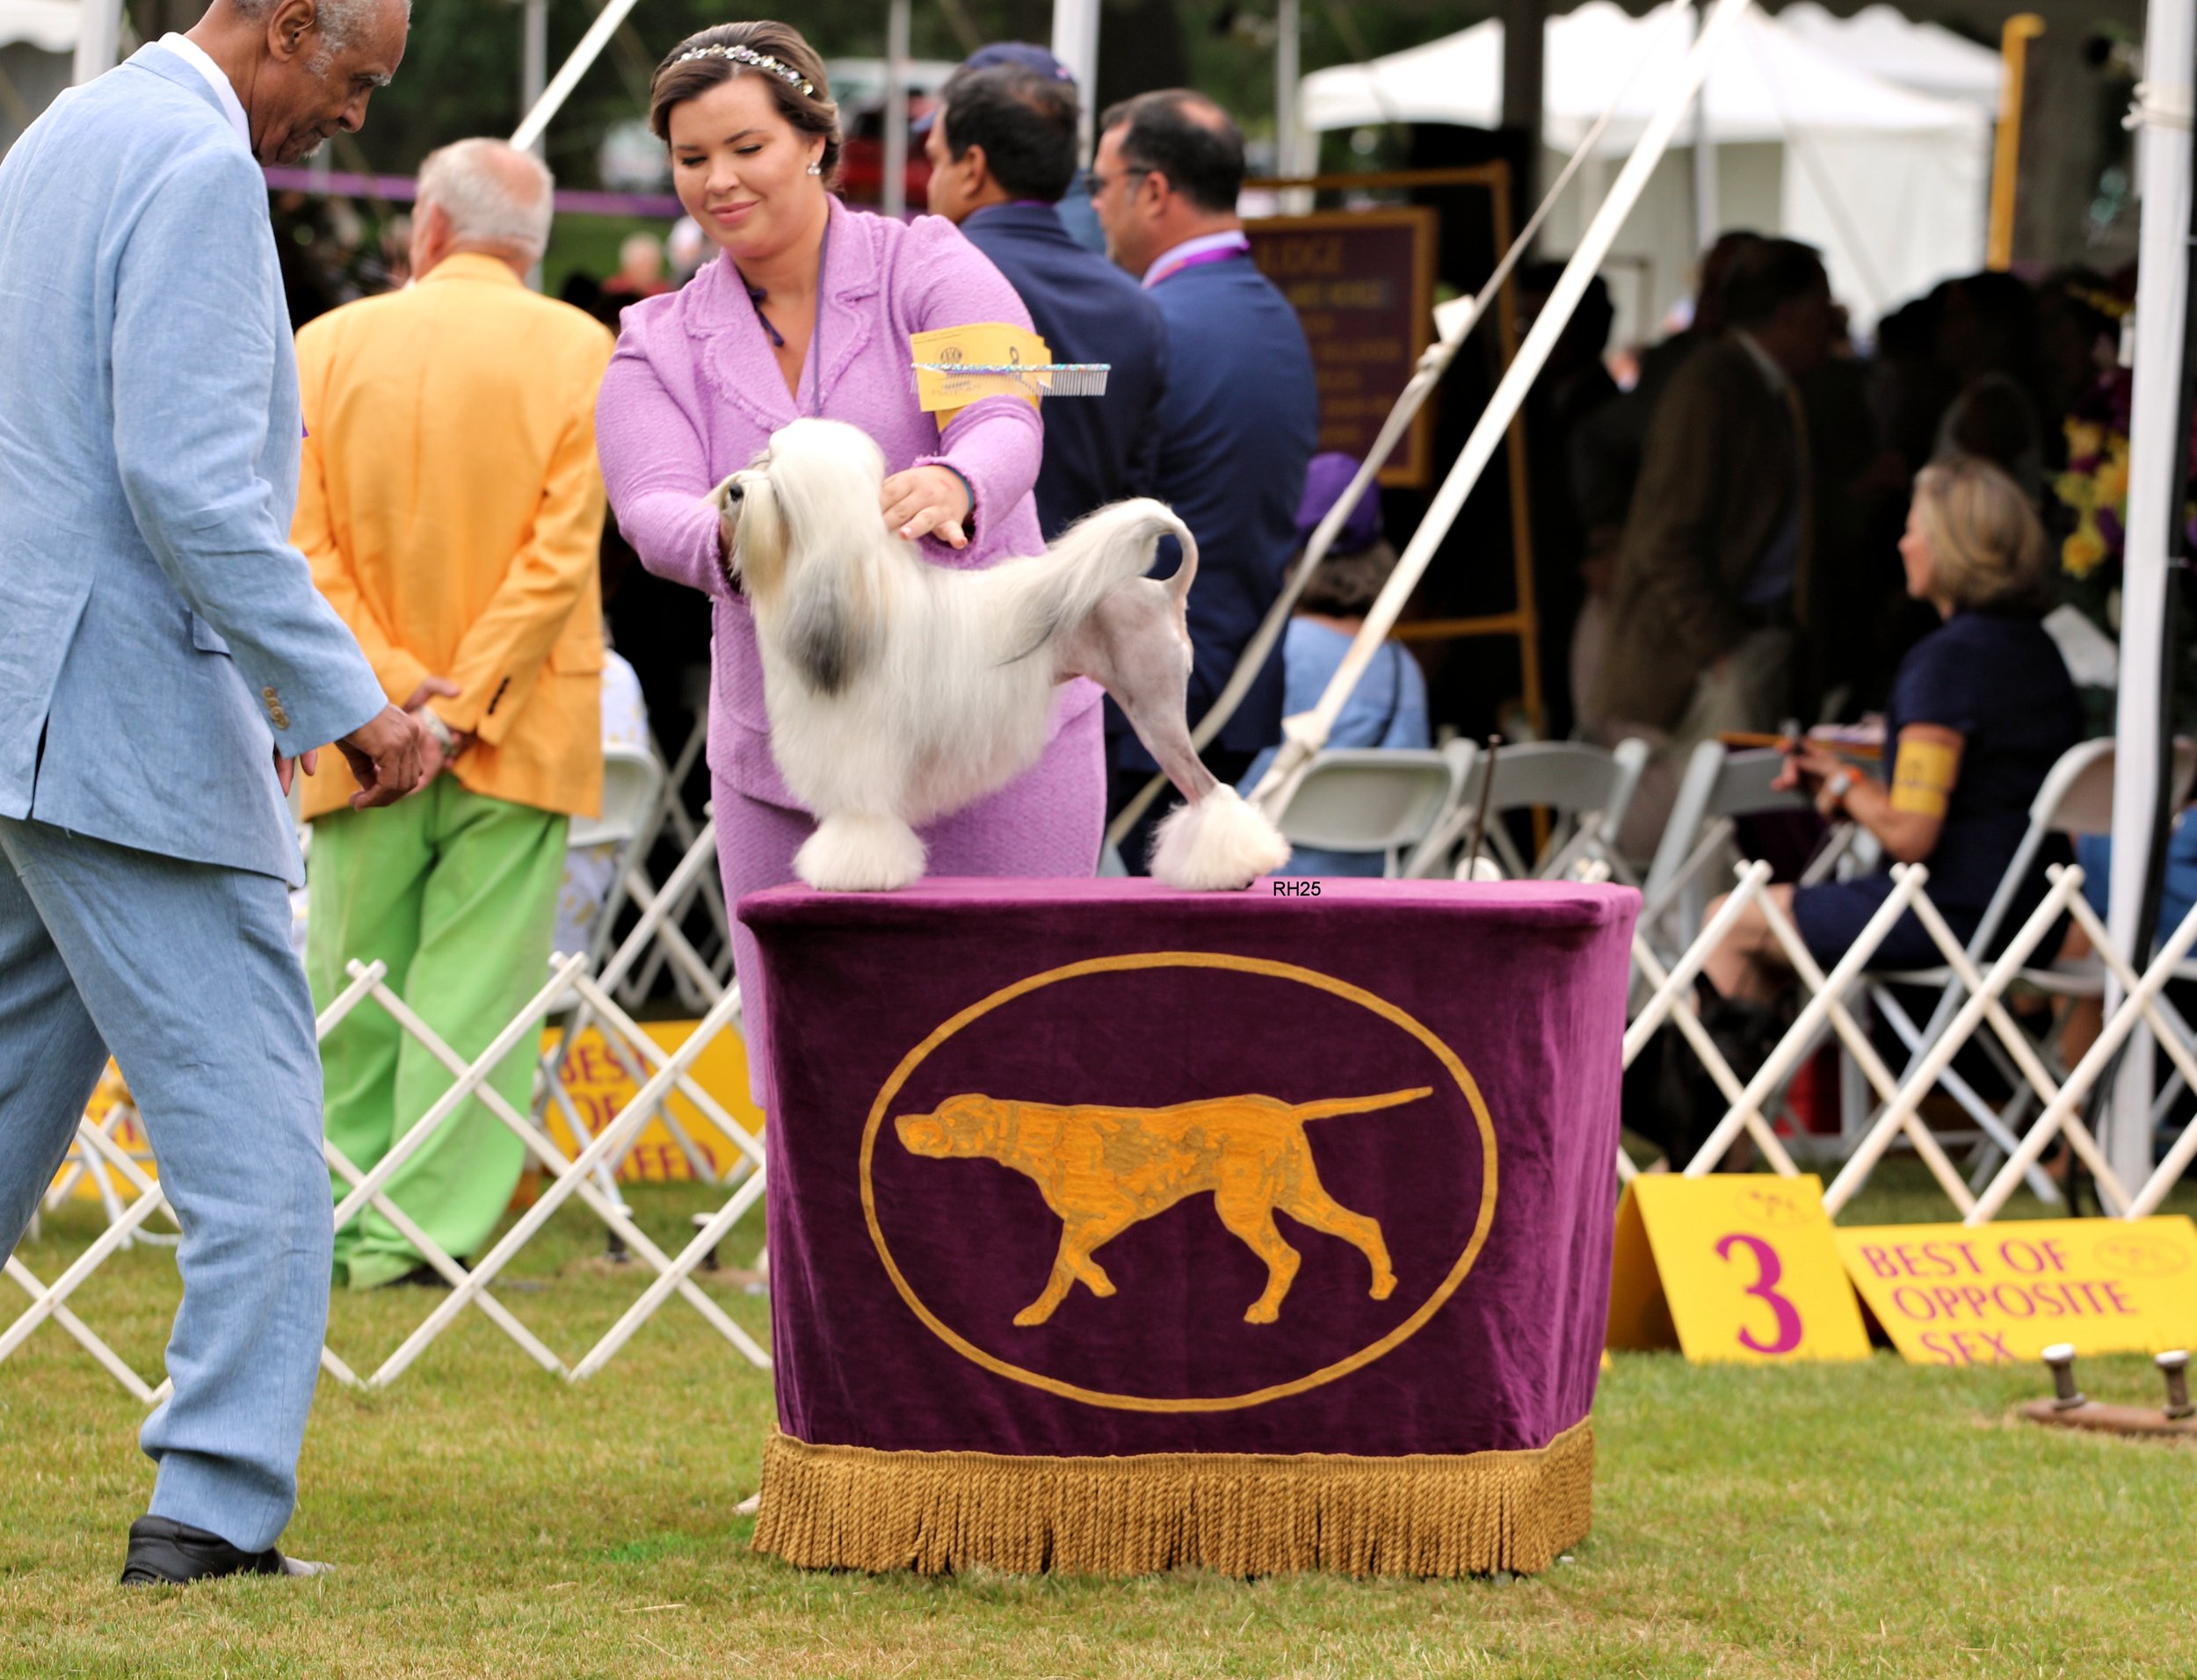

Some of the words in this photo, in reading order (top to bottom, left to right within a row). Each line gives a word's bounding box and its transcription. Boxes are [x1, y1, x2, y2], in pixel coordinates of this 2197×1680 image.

[1860, 1241, 1983, 1278] BEST
[1998, 1239, 2067, 1274] OF
[1714, 1233, 1804, 1355] 3
[1892, 1280, 2138, 1321] OPPOSITE
[1919, 1331, 2015, 1365] SEX
